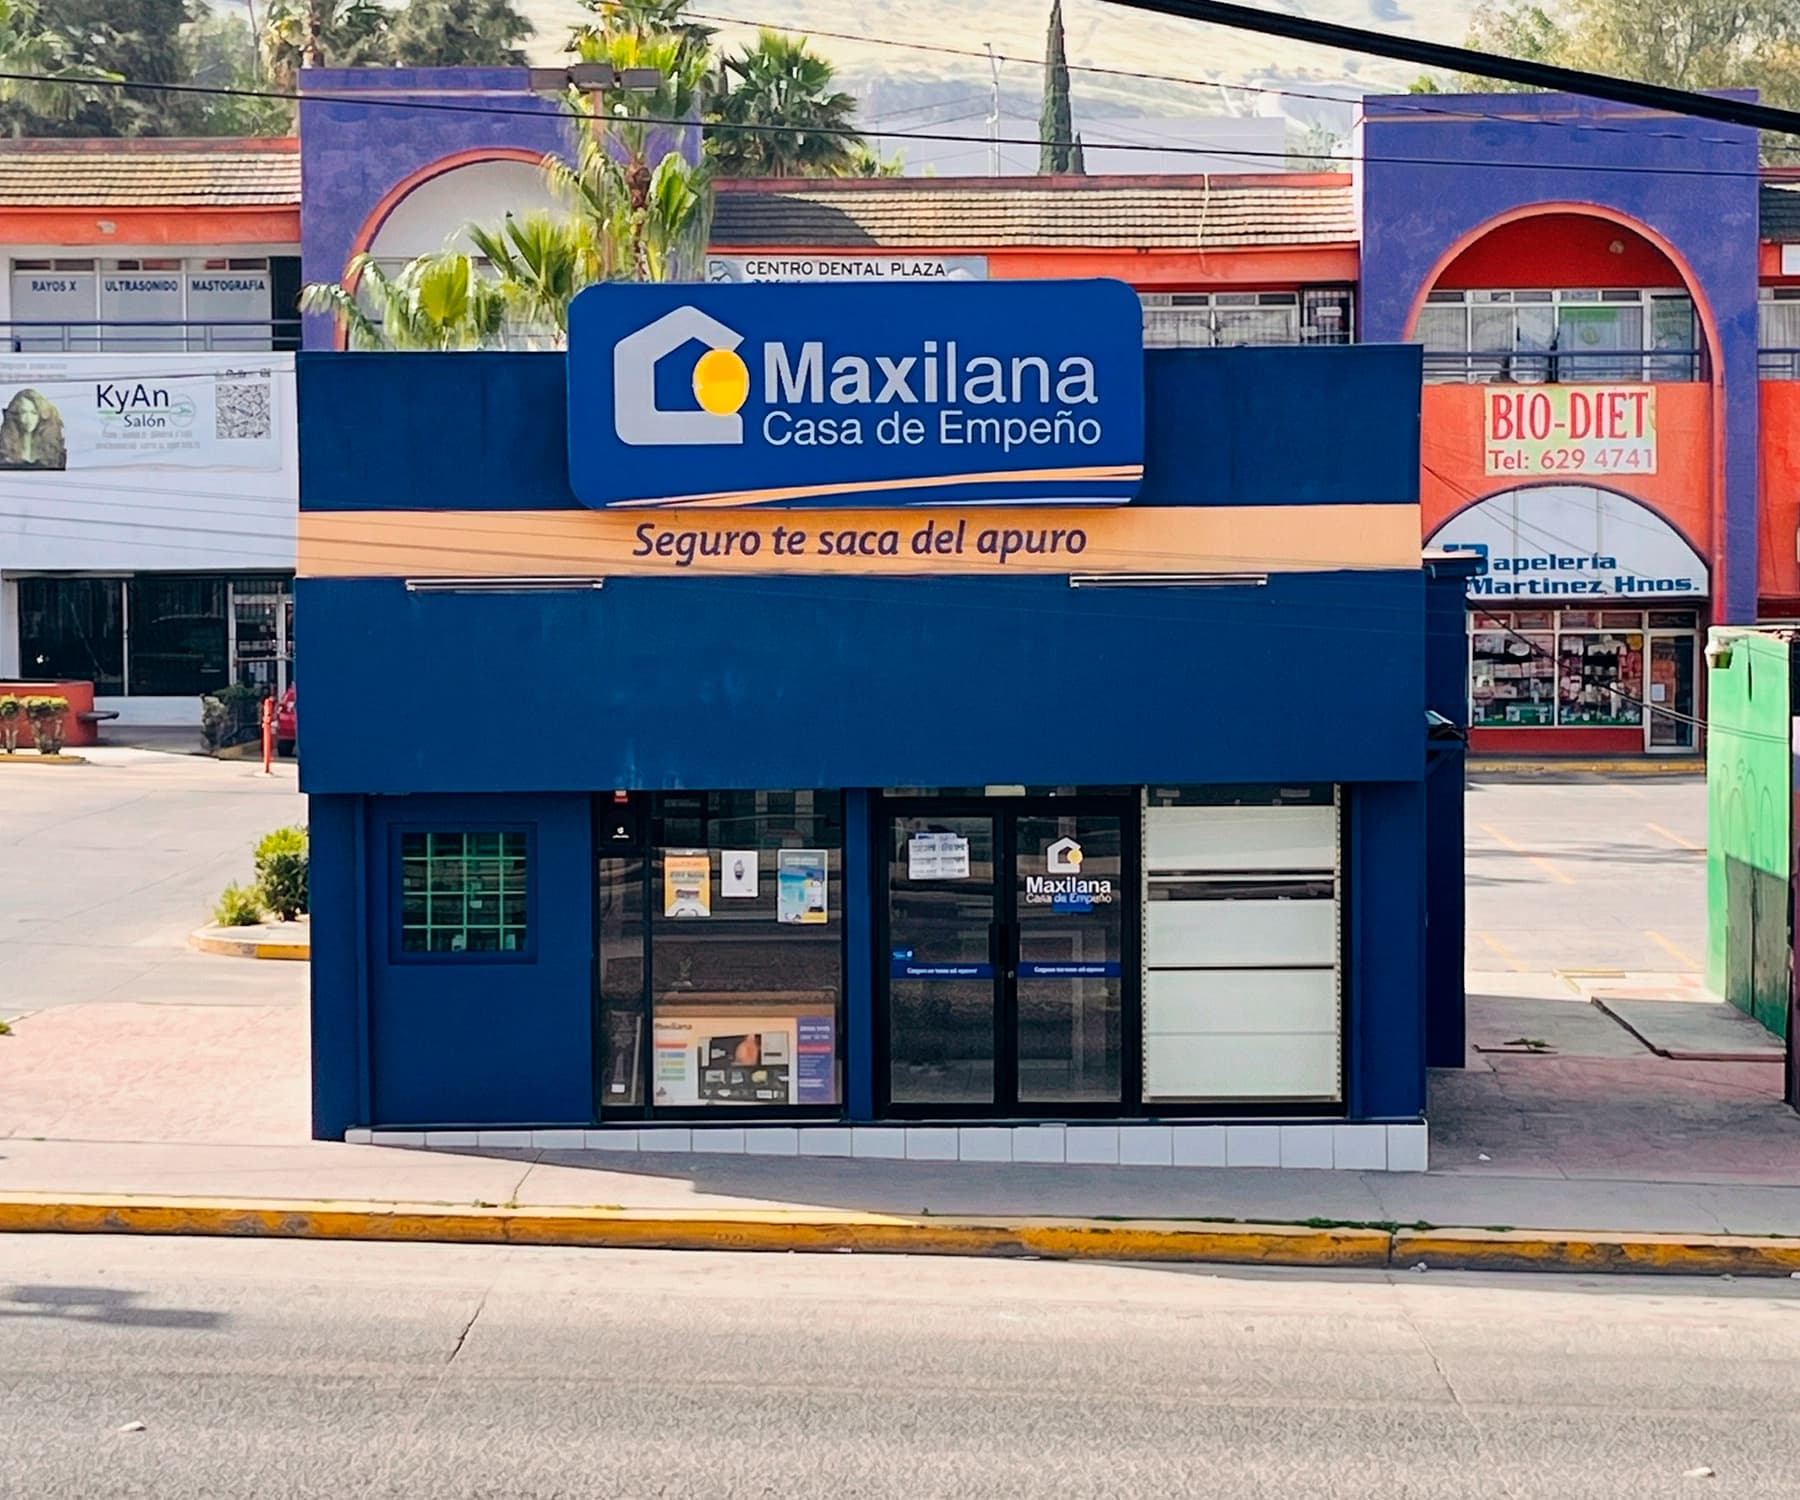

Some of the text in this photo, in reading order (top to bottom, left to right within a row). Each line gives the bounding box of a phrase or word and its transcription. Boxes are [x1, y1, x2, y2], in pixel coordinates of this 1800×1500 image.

[745, 261, 946, 277] CENTRO DENTAL PLAZA
[32, 280, 77, 292] RAYOS X
[105, 280, 178, 292] ULTRASONIDO
[763, 340, 1098, 405] Maxilana
[97, 384, 169, 414] KyAn
[124, 414, 166, 428] Salón
[1491, 392, 1648, 440] BIO-DIET
[763, 409, 1101, 452] Casa de Empeño
[1488, 448, 1653, 470] Tel: 629 4741
[632, 520, 1087, 567] Seguro te saca del apuro
[1614, 576, 1700, 593] Hnos.
[1026, 876, 1111, 893] Maxilana
